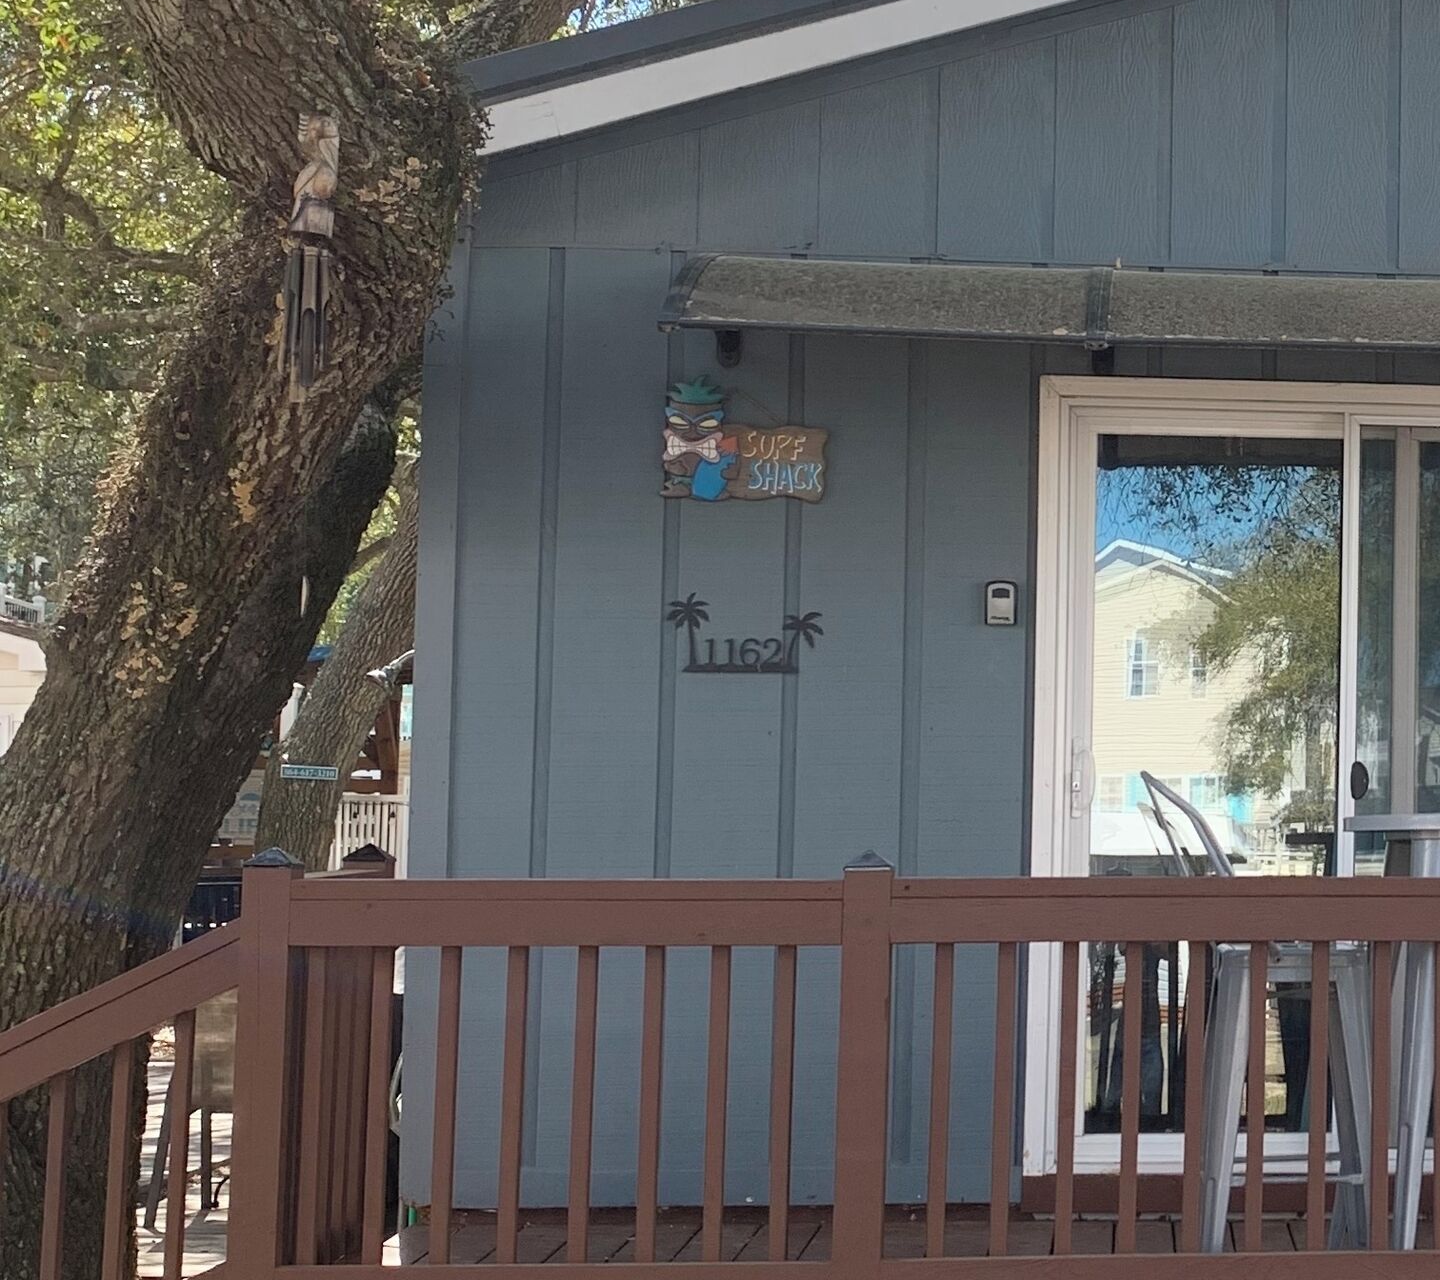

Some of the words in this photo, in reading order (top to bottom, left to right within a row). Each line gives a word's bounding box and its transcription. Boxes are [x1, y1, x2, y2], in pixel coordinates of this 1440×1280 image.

[741, 431, 807, 461] SURF
[747, 459, 823, 495] SHACK
[704, 637, 783, 665] 1162
